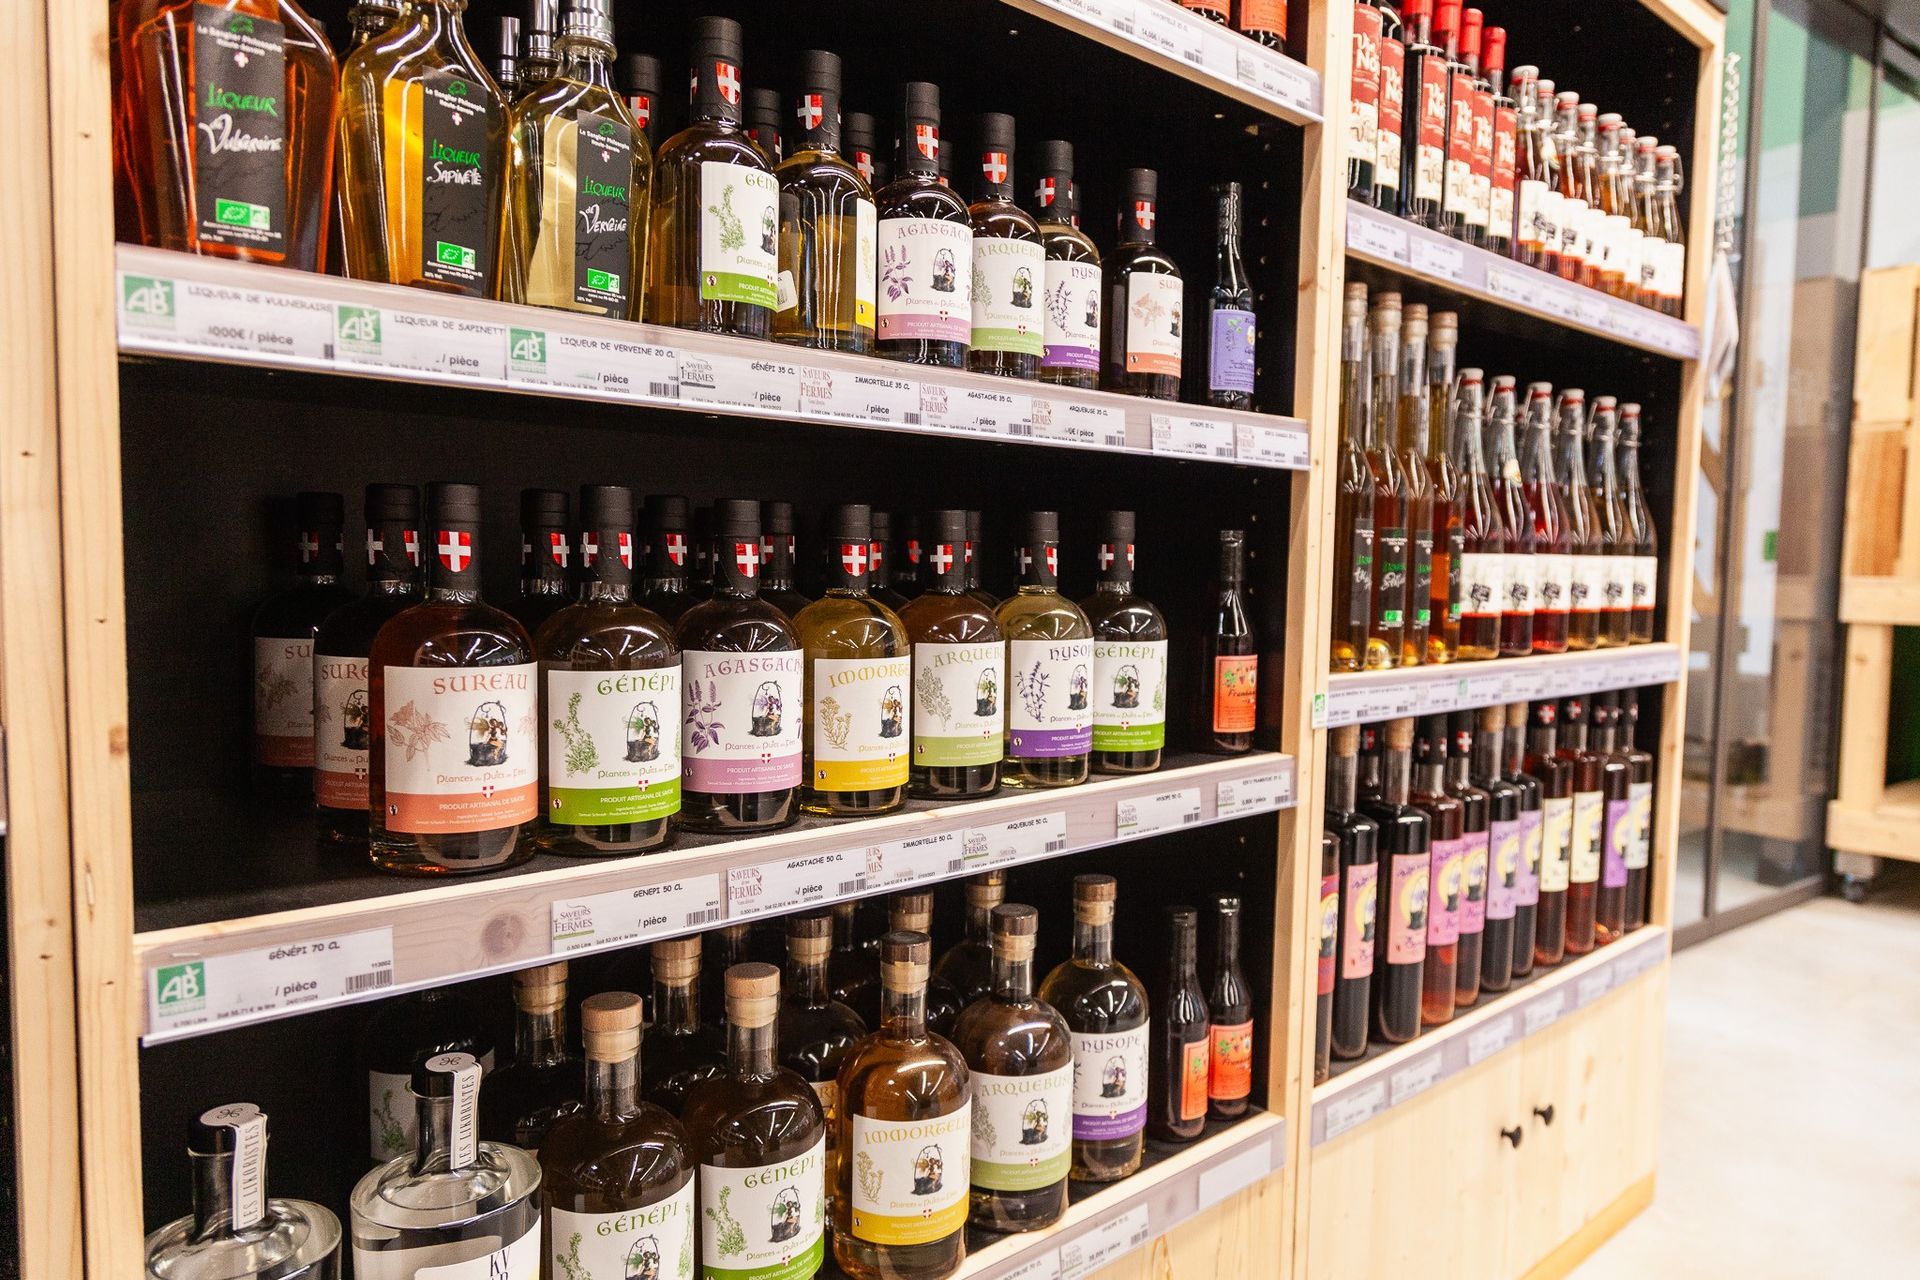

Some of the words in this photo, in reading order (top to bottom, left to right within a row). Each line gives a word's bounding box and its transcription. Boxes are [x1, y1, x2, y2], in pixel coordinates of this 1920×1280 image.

[394, 314, 438, 329] LIQUEUR
[442, 321, 455, 332] DE
[257, 332, 293, 346] pièce
[560, 336, 598, 350] LIQUEUR
[601, 342, 611, 351] DE
[614, 343, 652, 356] VERVEINE
[655, 348, 664, 357] 20
[666, 350, 675, 359] CL
[449, 355, 479, 368] pièce
[751, 361, 776, 372] GÉNÉPI
[603, 373, 629, 385] pièce
[855, 376, 893, 388] IMMORTELLE
[759, 392, 781, 402] pièce
[870, 404, 890, 415] pièce
[1095, 643, 1155, 659] GÉNÉPI
[433, 673, 528, 695] SUREAU
[597, 673, 675, 696] GÉNÉPI
[440, 802, 468, 811] PRODUIT
[600, 796, 627, 804] PRODUIT
[903, 836, 937, 848] IMMORTELLE
[786, 856, 824, 869] AGASTACHE
[826, 855, 834, 863] 50
[836, 853, 843, 861] CL
[730, 867, 760, 882] SAVEURS
[633, 887, 661, 899] GENEPI
[663, 885, 672, 893] 50
[674, 883, 683, 891] CL
[729, 882, 763, 900] FERMES
[802, 883, 823, 896] pièce
[560, 907, 592, 919] SAVEURS
[555, 918, 593, 933] FERMES
[643, 915, 667, 928] pièce
[269, 944, 308, 961] GÉNÉPI
[311, 942, 325, 953] 70
[328, 940, 340, 950] CL
[283, 980, 317, 996] pièce
[460, 1143, 472, 1165] LES
[744, 1155, 816, 1189] GÉNÉPI
[243, 1200, 258, 1225] LES
[596, 1201, 679, 1236] GÉNÉPI
